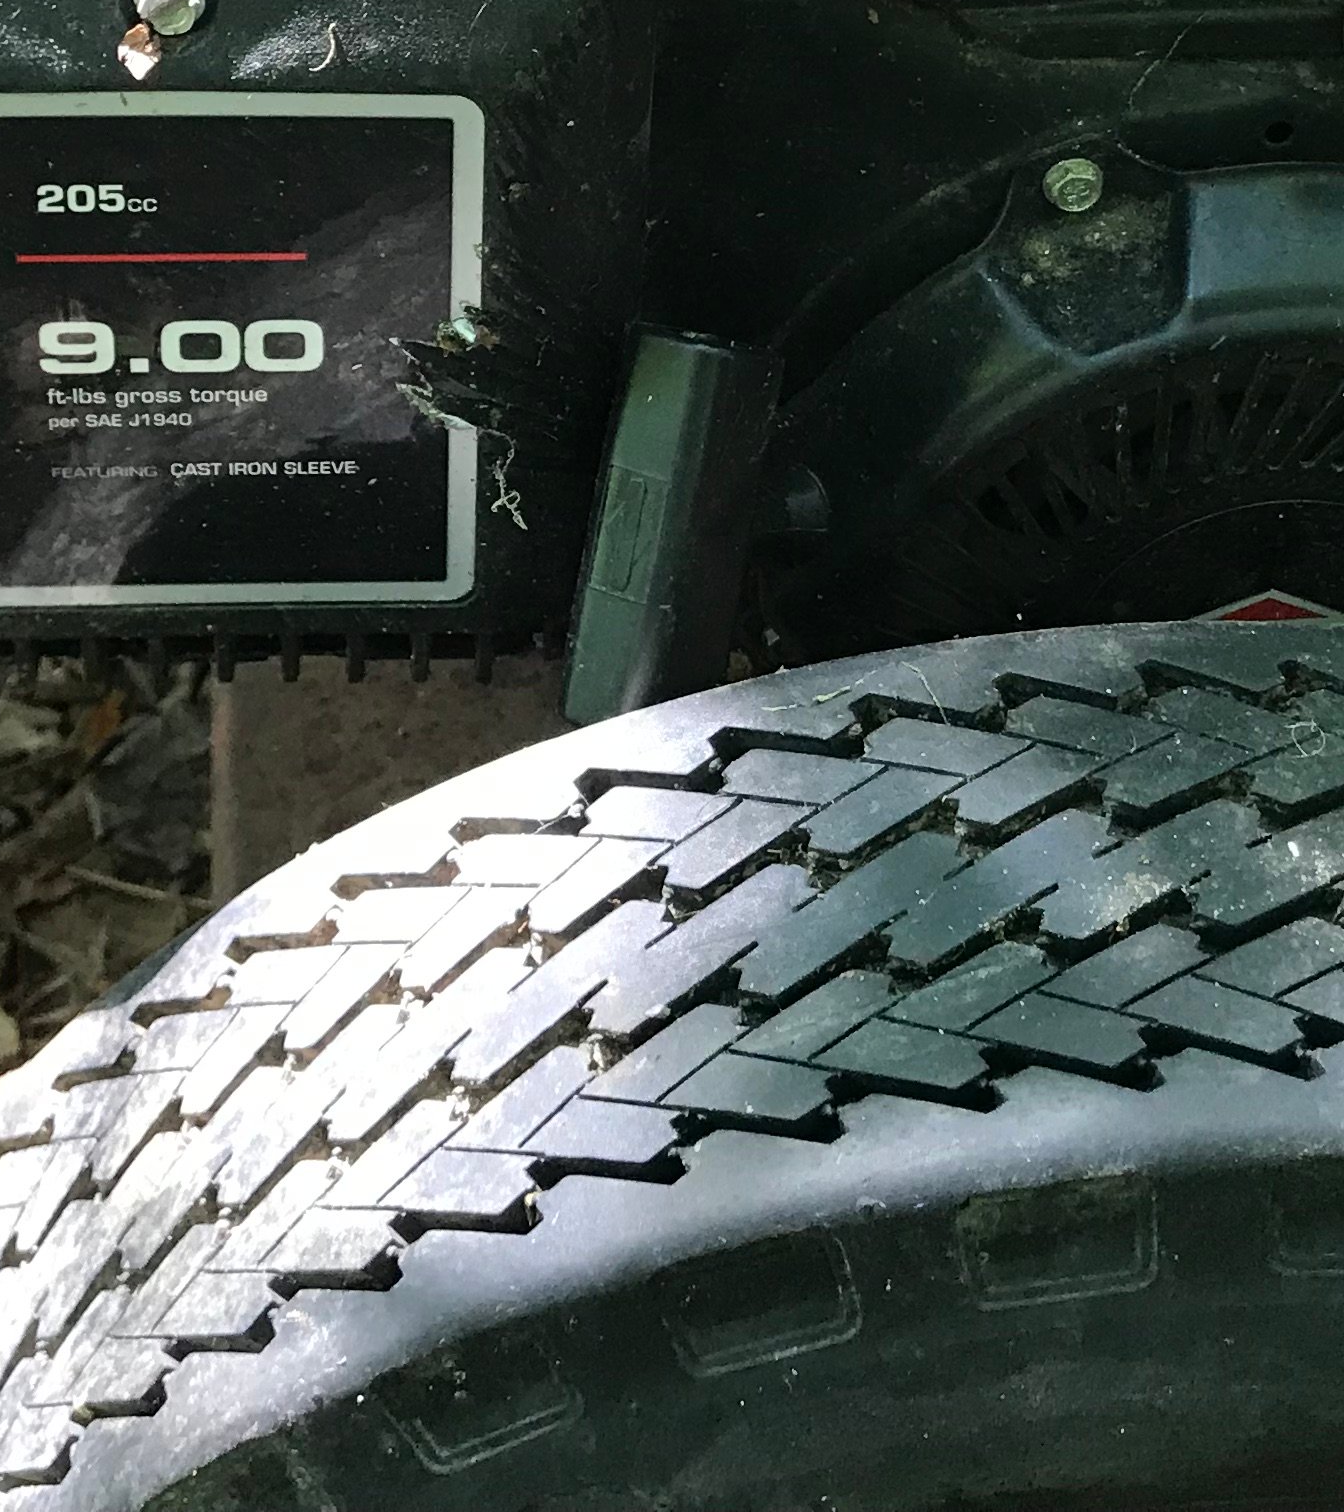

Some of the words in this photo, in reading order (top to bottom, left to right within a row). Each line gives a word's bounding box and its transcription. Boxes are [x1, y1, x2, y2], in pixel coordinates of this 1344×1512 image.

[36, 184, 159, 214] 205cc
[38, 319, 325, 375] 9.00
[46, 388, 107, 406] ft-lbs
[114, 390, 182, 408] gross
[189, 388, 269, 407] torque
[47, 415, 81, 430] per
[84, 413, 124, 428] SAE
[128, 412, 194, 428] J1940
[50, 464, 159, 480] FEATURING
[169, 461, 224, 478] CAST
[228, 462, 278, 477] IRON
[283, 460, 359, 476] SLEEVE
